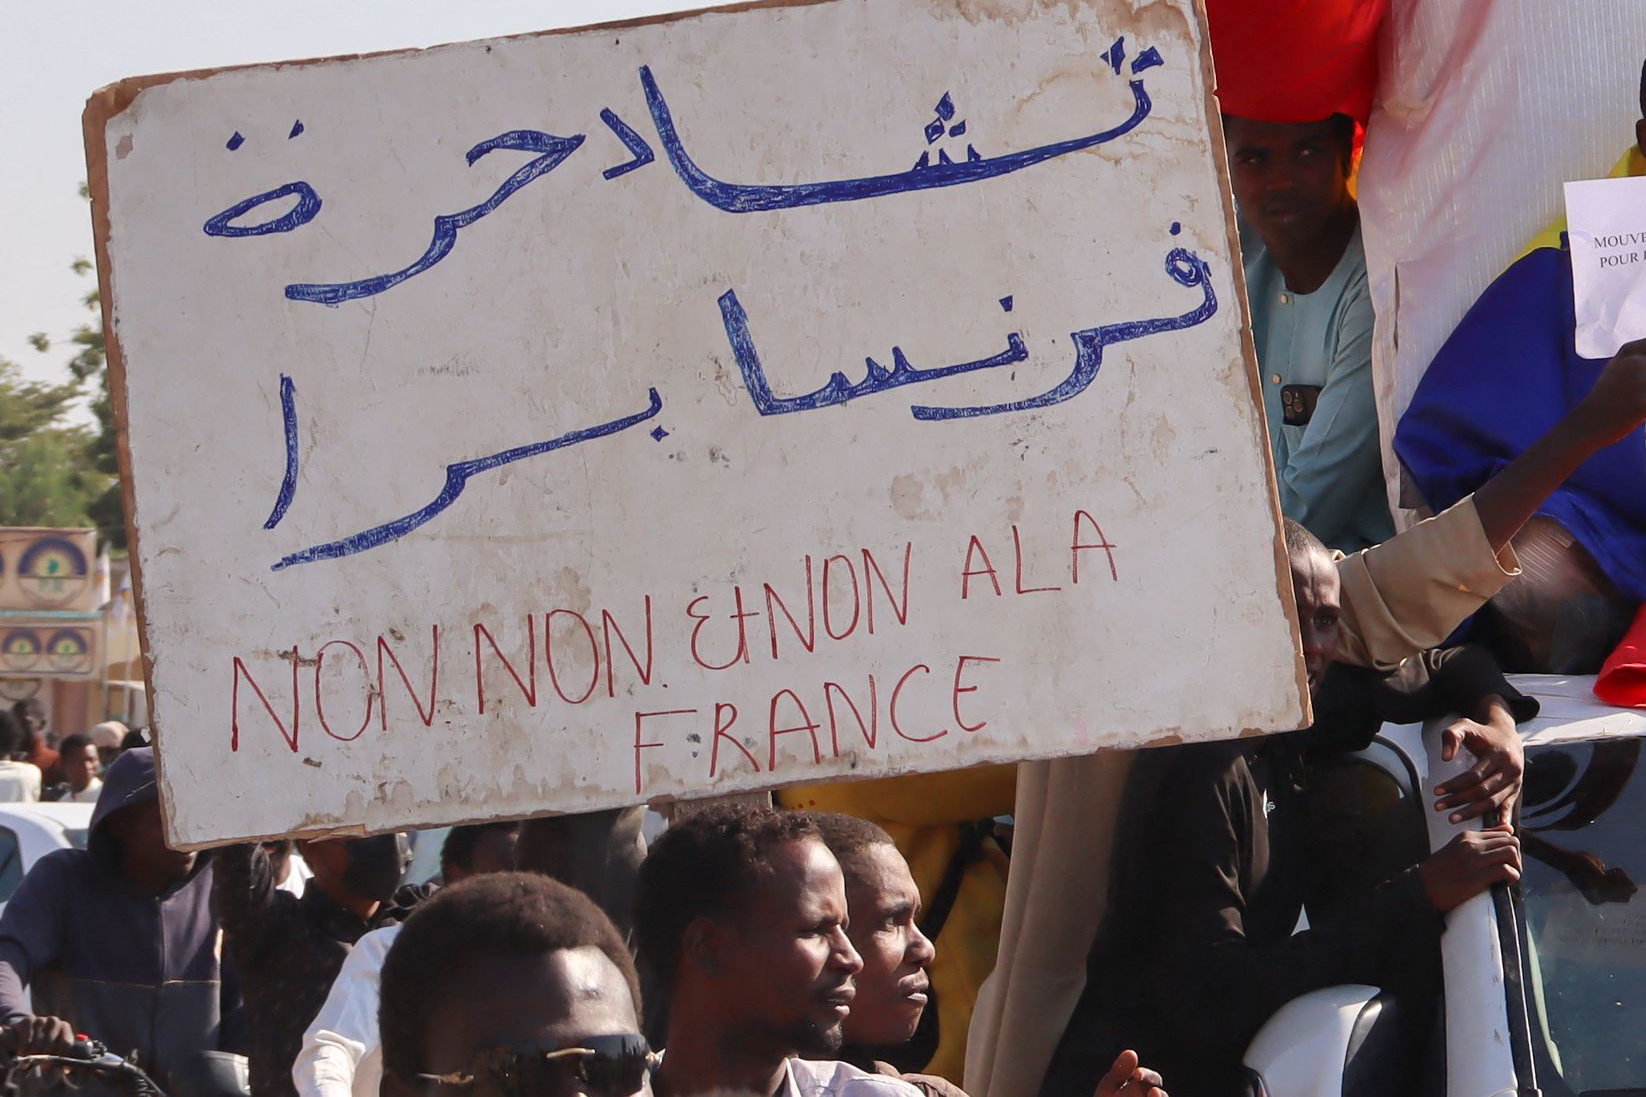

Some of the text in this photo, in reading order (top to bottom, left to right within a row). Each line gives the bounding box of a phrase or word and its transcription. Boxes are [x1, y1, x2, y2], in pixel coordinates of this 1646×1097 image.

[204, 37, 1164, 306] تشاد حرة
[1600, 253, 1639, 268] POUR
[263, 221, 1218, 571] فرنسا برا
[230, 624, 439, 753] NON
[473, 594, 652, 715] NON
[763, 541, 912, 660] NON
[633, 655, 1001, 795] FRANCE
